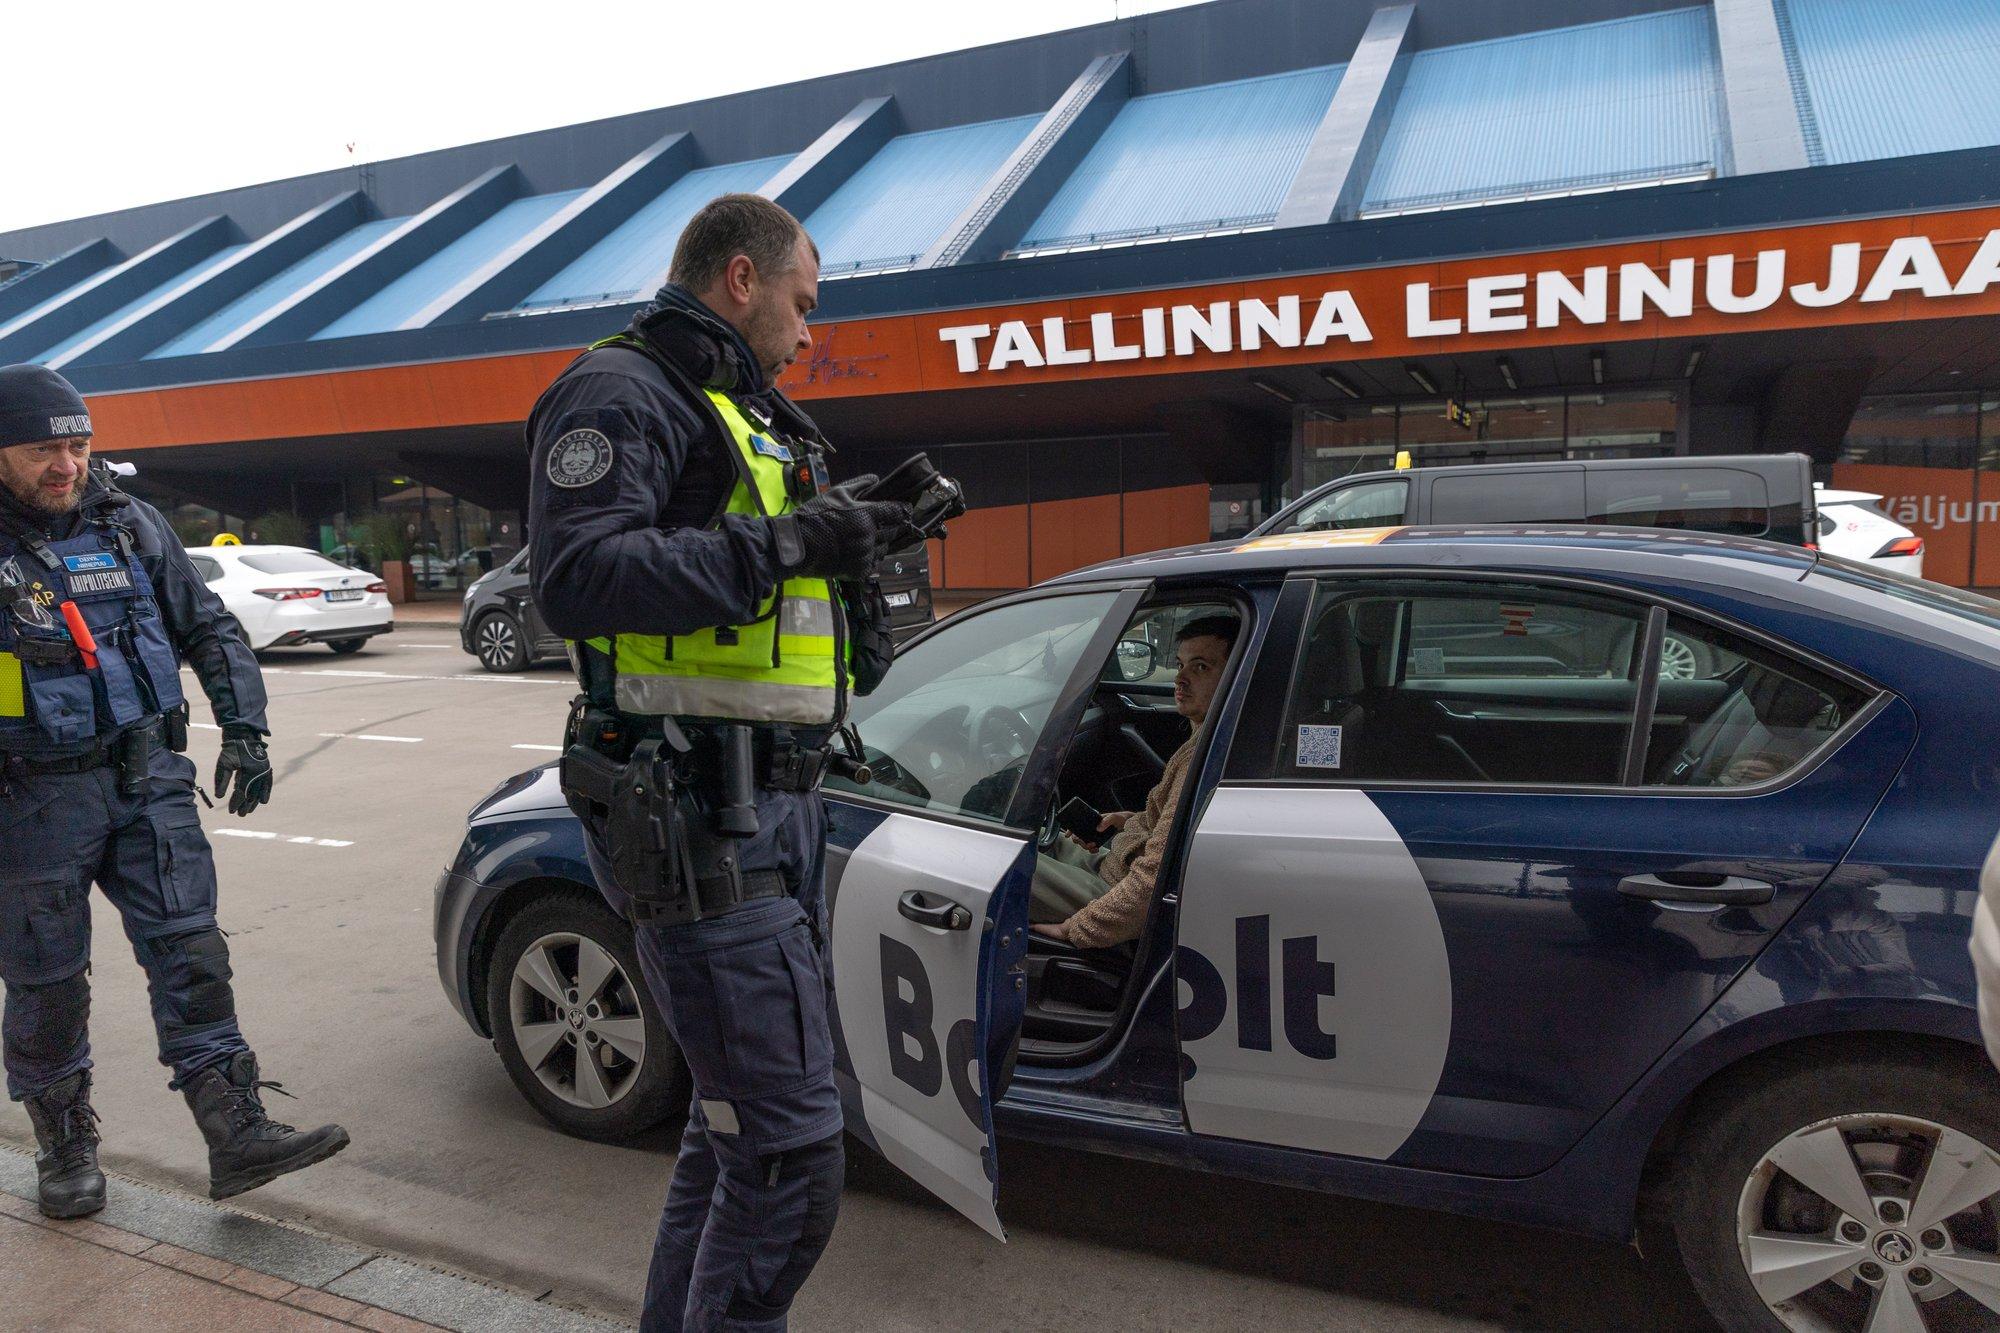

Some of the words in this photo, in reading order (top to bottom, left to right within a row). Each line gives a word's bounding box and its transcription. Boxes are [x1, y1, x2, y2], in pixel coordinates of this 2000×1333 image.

[939, 290, 1374, 373] TALLINNA
[551, 466, 576, 484] BORDER
[580, 462, 607, 483] GUARD
[70, 570, 131, 594] ABIPOLITSEINIK
